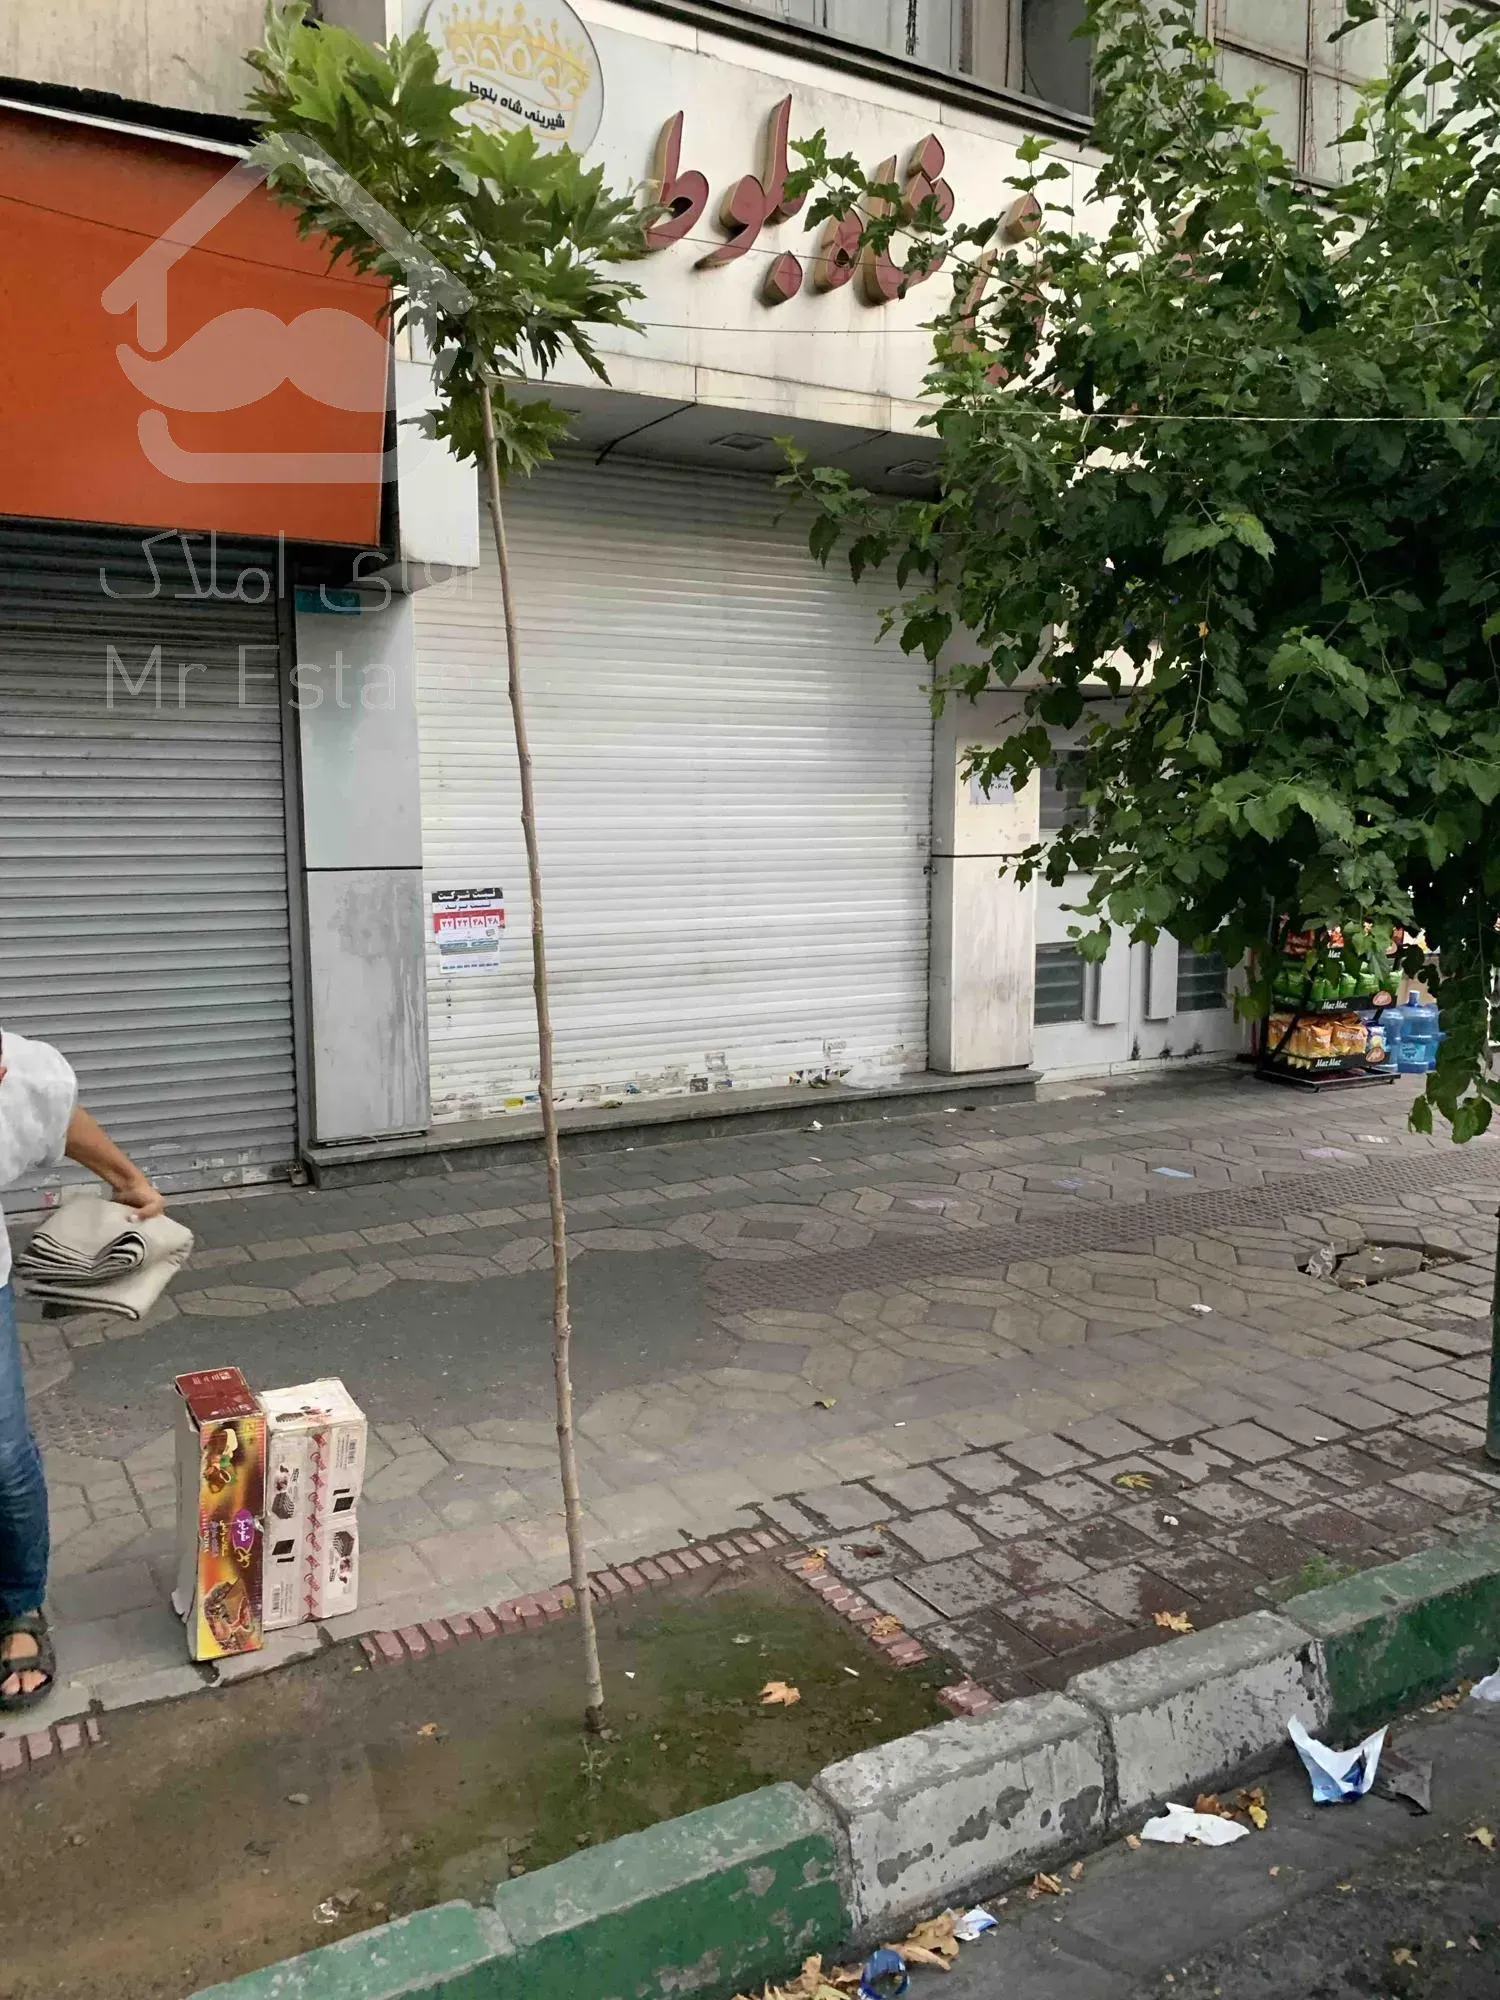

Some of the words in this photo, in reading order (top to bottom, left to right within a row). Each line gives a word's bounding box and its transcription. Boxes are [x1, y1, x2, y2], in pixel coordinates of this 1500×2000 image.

[469, 80, 498, 105] بلوط
[500, 98, 523, 115] شاه
[525, 110, 565, 130] شیرینی
